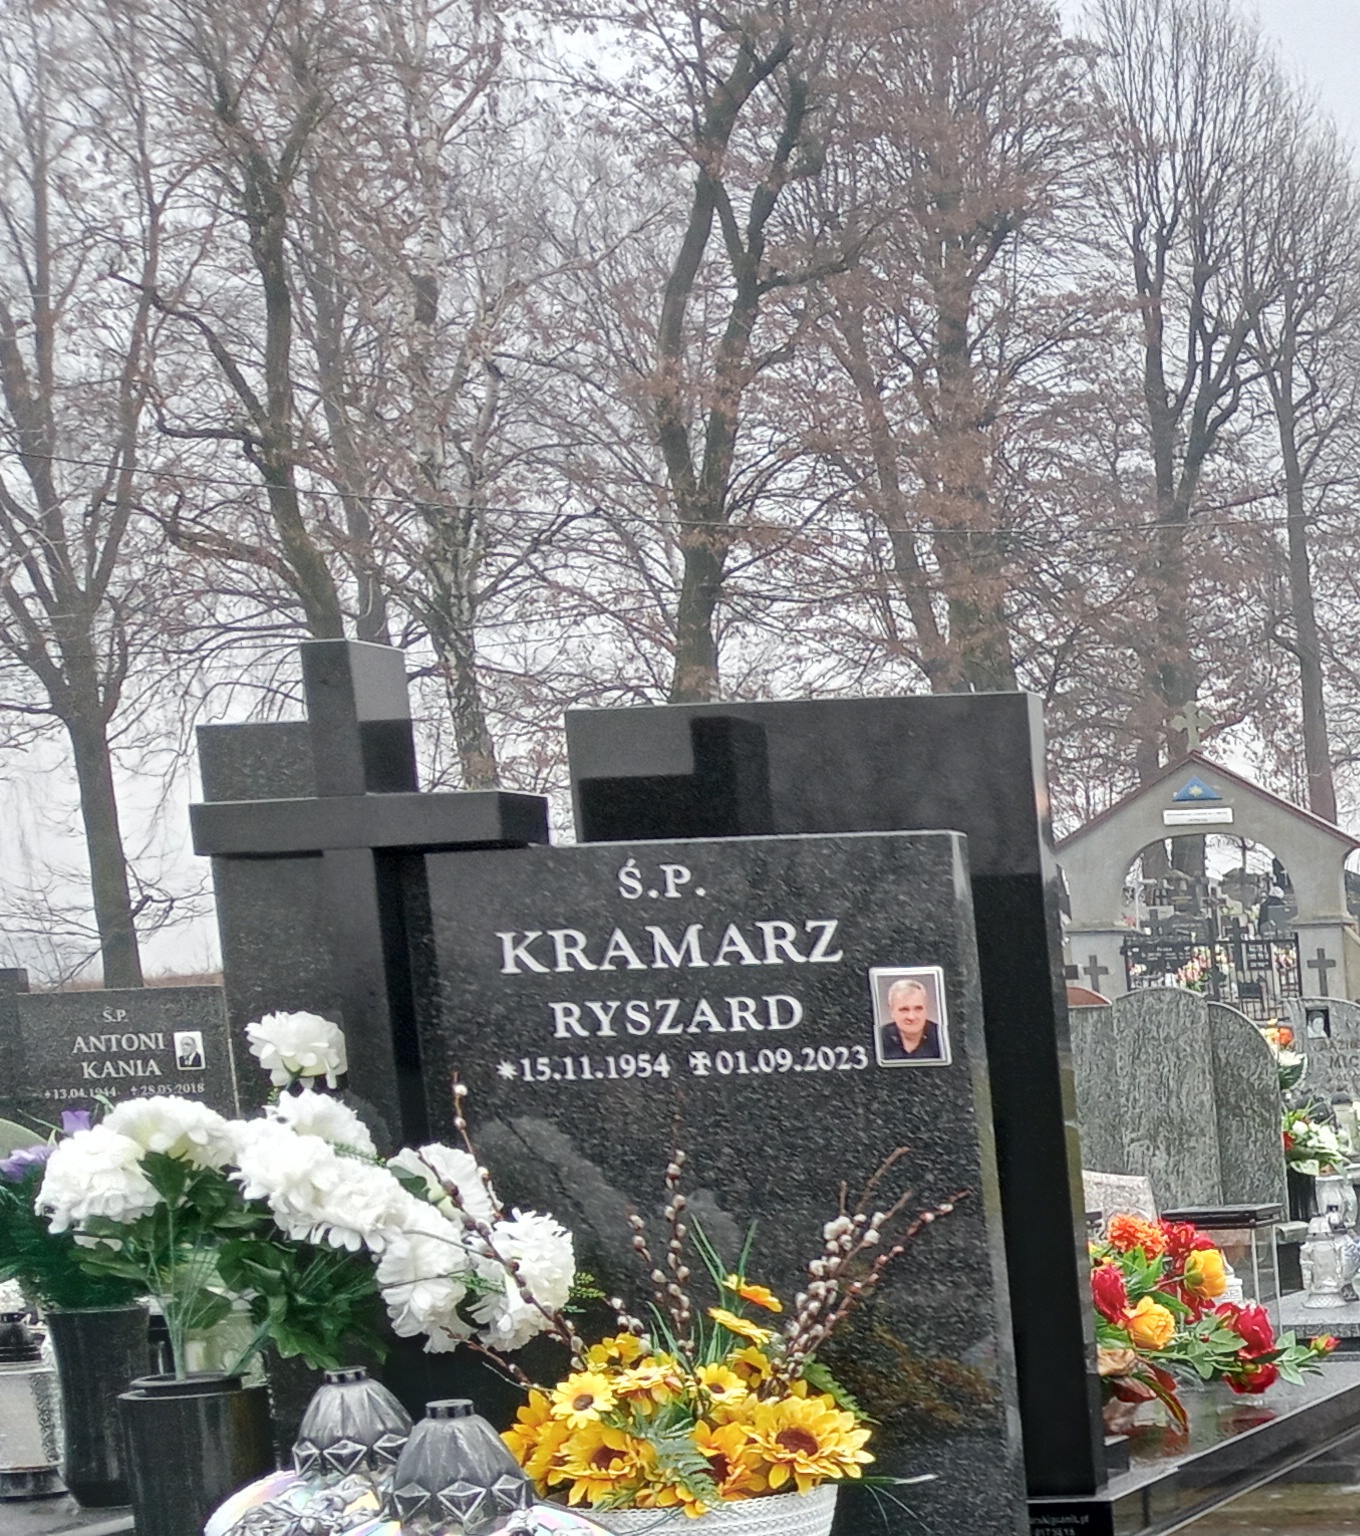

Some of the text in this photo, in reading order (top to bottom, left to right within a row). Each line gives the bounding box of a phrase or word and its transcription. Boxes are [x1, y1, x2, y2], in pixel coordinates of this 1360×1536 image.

[617, 857, 707, 901] Ś.P.
[495, 918, 844, 976] KRAMARZ
[548, 994, 804, 1040] RYSZARD
[72, 1032, 168, 1054] ANTONI
[81, 1058, 163, 1080] KANIA
[519, 1045, 869, 1083] 15.11.1954 01.09.2023
[139, 1081, 206, 1097] 28.05.2018
